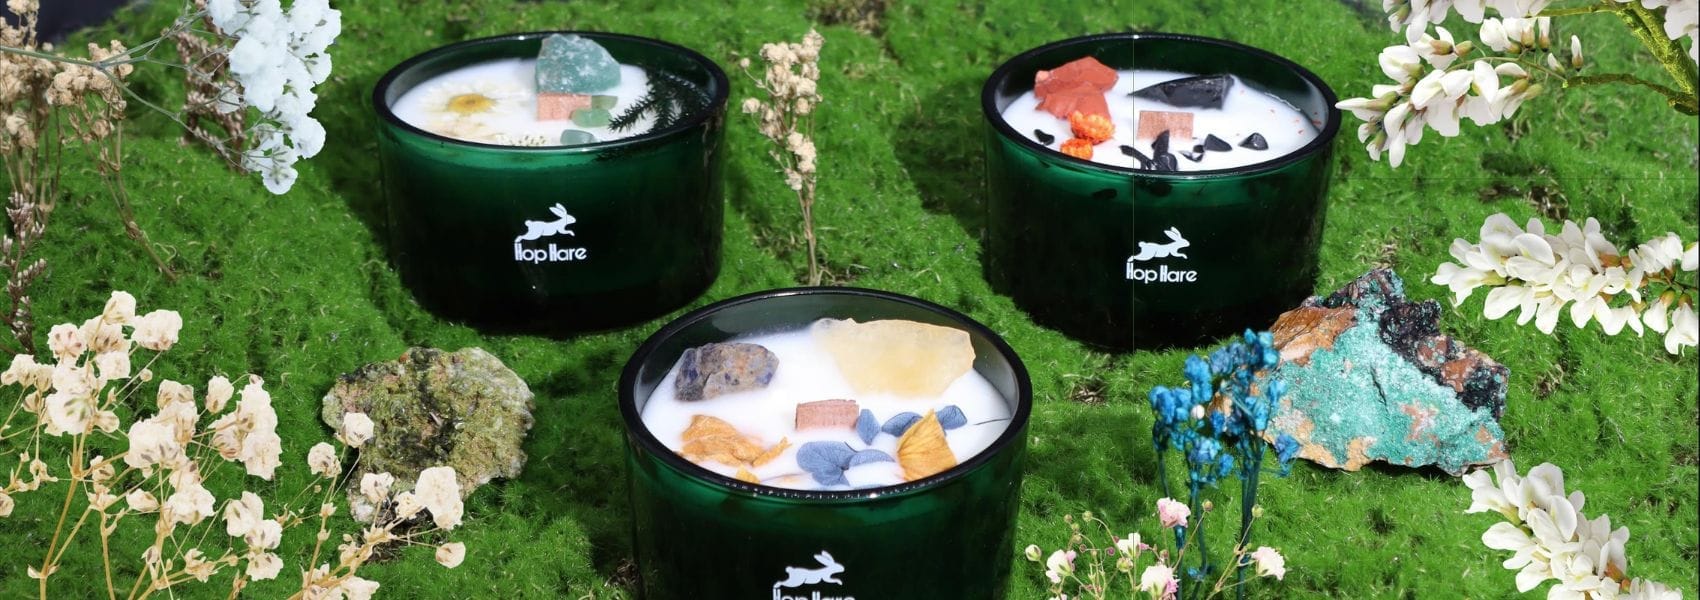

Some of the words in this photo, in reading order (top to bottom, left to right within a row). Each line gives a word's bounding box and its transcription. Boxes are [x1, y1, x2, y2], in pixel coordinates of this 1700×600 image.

[514, 243, 547, 264] Hop
[548, 243, 587, 261] Hare
[1126, 262, 1158, 284] Hop
[1160, 265, 1198, 282] Hare
